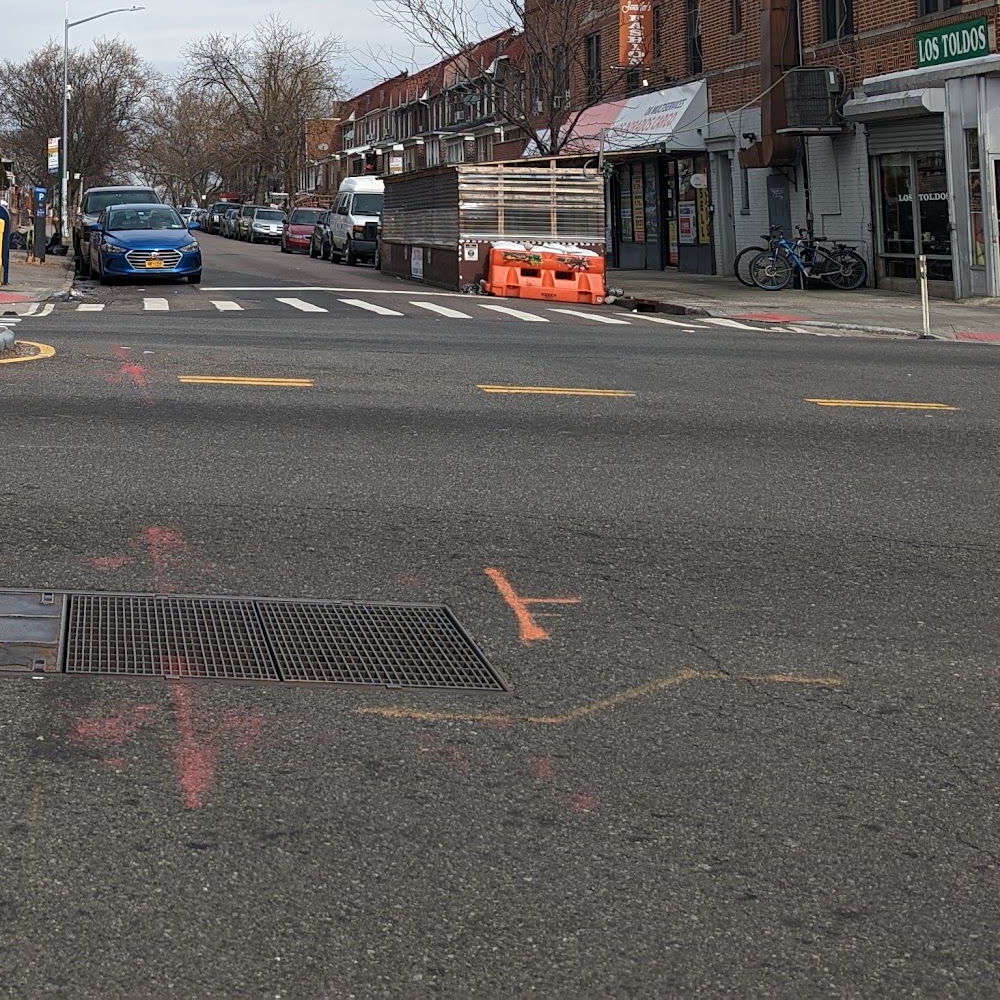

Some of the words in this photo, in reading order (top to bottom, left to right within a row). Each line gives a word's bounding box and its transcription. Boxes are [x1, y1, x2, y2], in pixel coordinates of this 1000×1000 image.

[918, 36, 940, 62] LOS
[941, 25, 987, 58] TOLDOS
[898, 193, 914, 202] LOS
